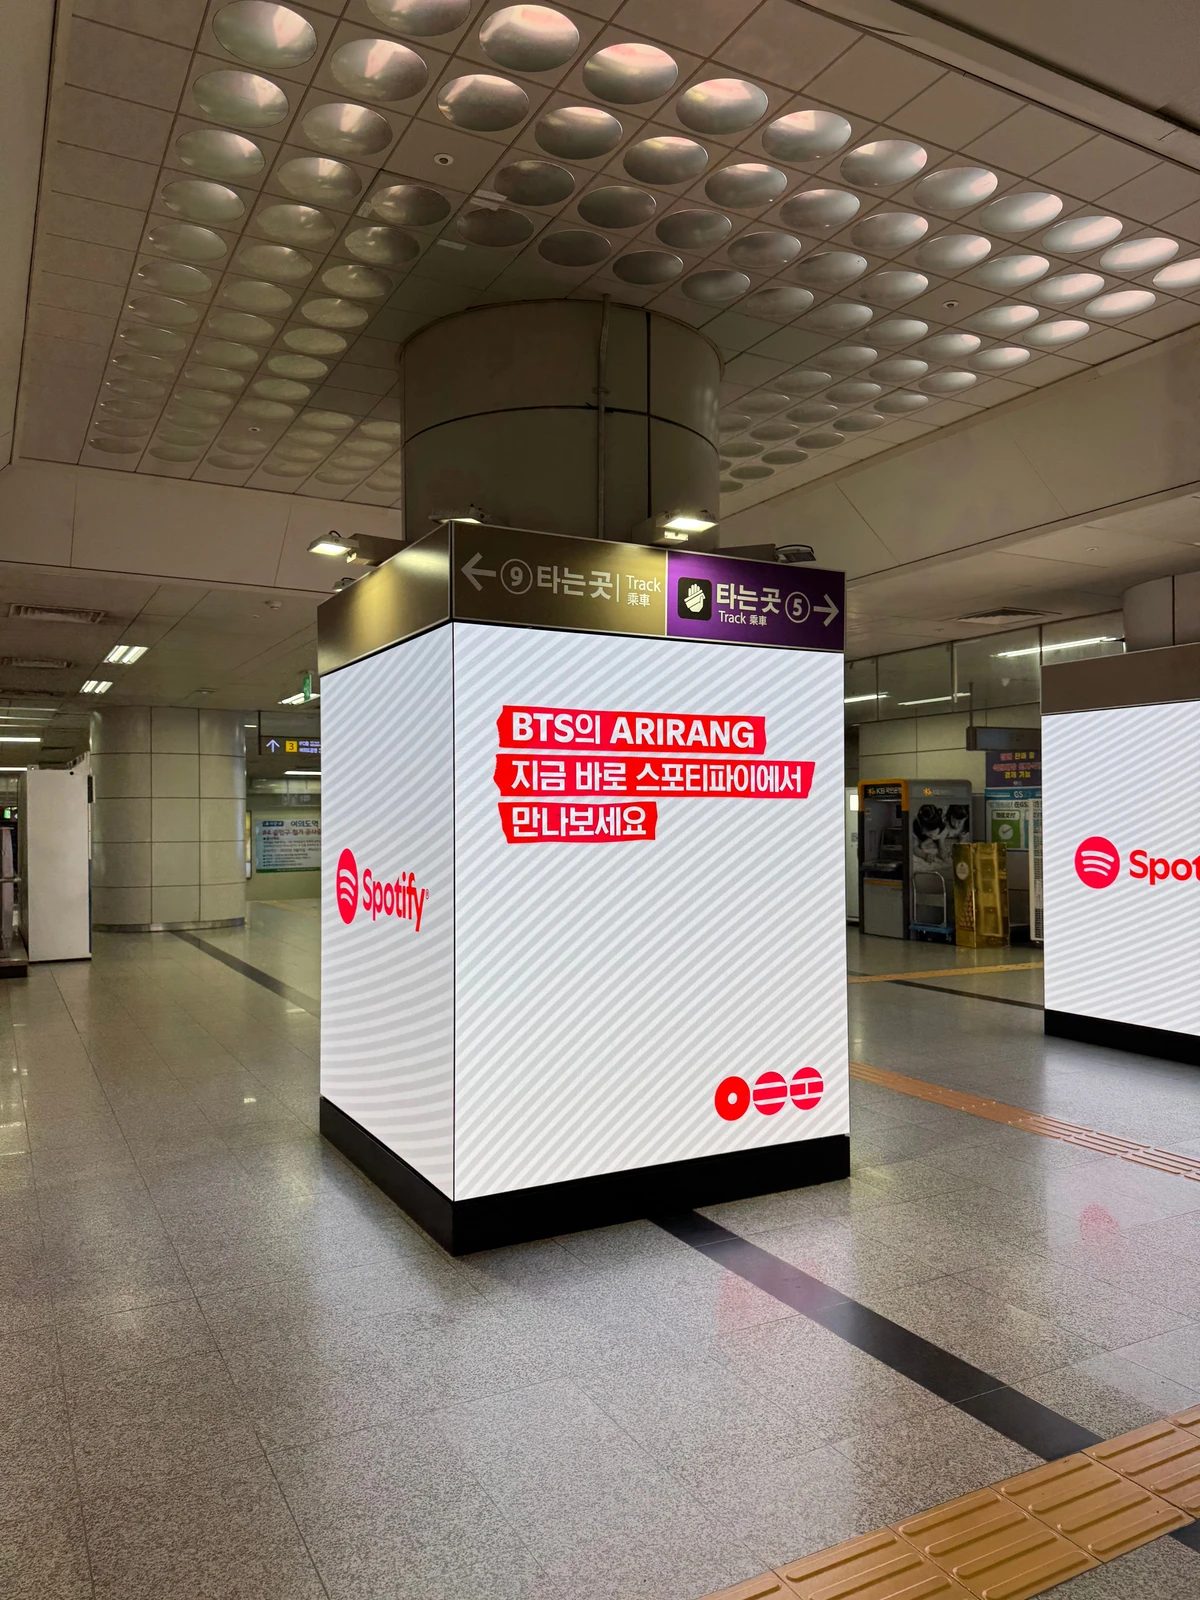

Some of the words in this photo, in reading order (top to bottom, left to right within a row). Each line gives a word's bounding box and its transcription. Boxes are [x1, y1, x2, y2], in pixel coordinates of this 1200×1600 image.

[537, 566, 614, 602] 타는곳
[626, 574, 662, 593] Track
[716, 583, 781, 614] 타는곳
[718, 610, 747, 624] Track
[512, 711, 601, 746] BTS의
[610, 716, 755, 748] ARIRANG
[511, 759, 567, 792] 지금
[575, 760, 627, 792] 바로
[635, 761, 803, 794] 스포티파이에서
[290, 819, 319, 828] 여의도역
[511, 806, 648, 839] 만나보세요
[362, 868, 426, 932] Spotify
